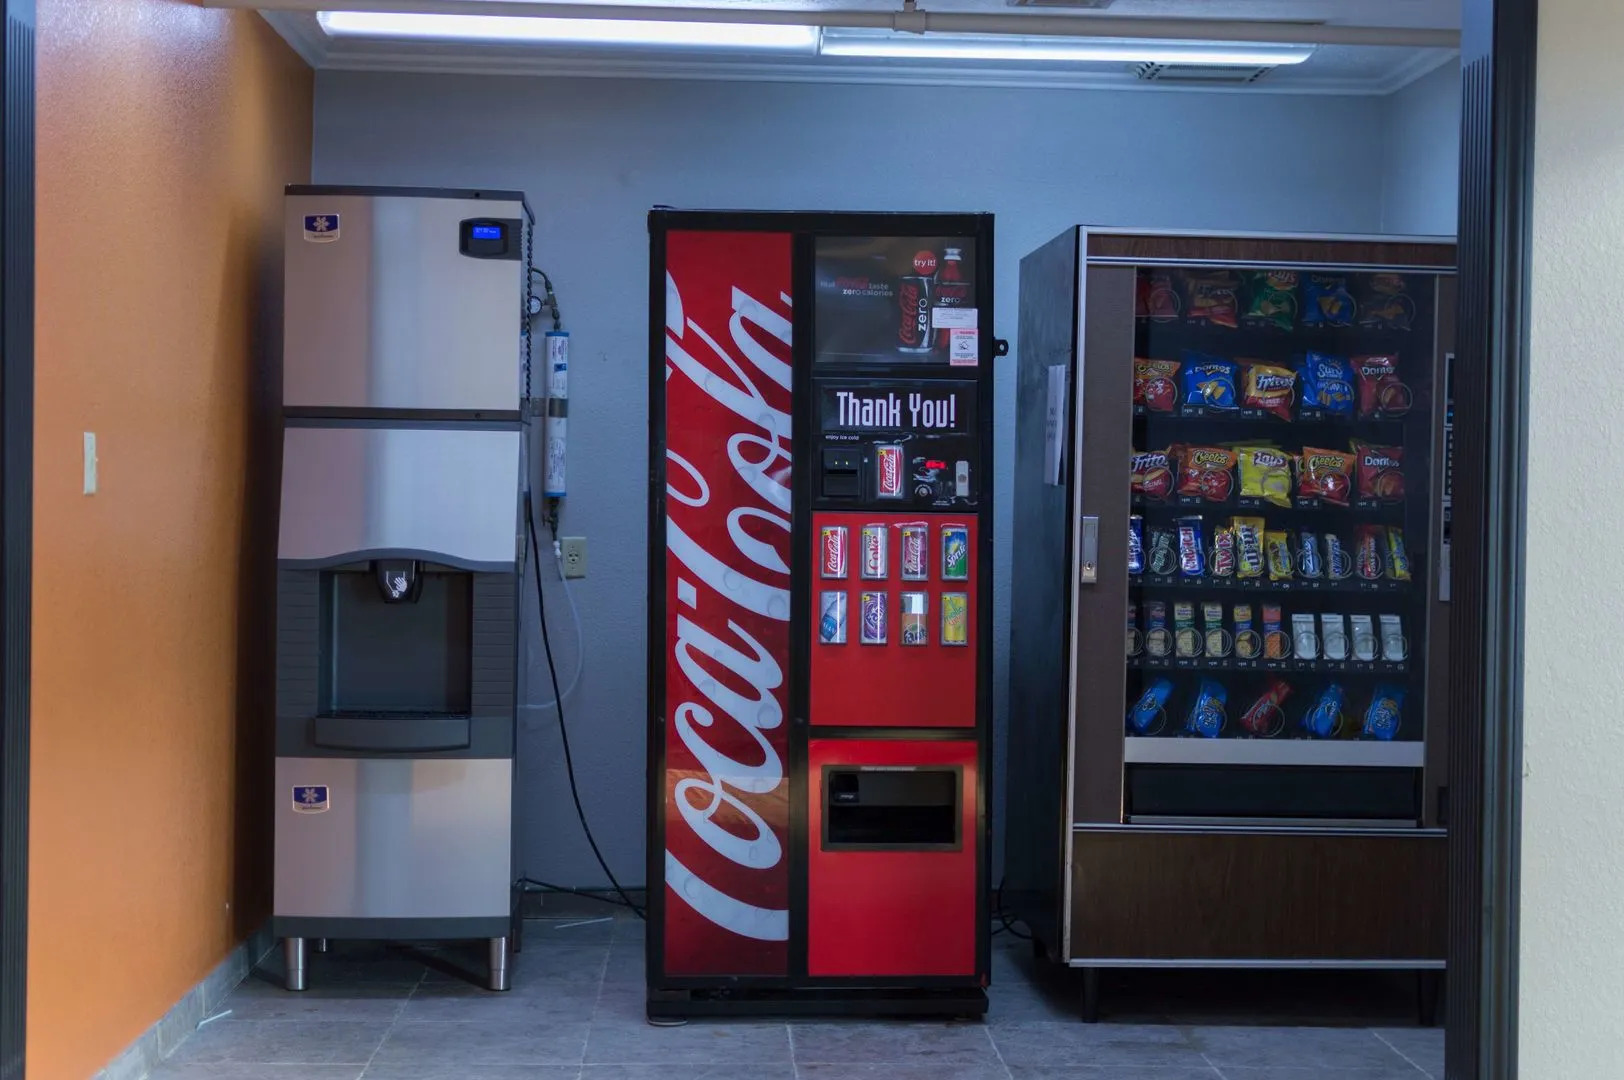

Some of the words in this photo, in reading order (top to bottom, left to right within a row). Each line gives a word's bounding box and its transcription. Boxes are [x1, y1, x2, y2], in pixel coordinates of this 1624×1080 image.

[914, 259, 926, 268] try
[927, 259, 936, 267] it!
[842, 288, 861, 296] zero
[941, 295, 961, 303] zero
[918, 298, 928, 332] zero
[1194, 364, 1231, 375] Doritos
[836, 391, 901, 427] Thank
[908, 392, 956, 428] You!
[1193, 450, 1229, 465] Cheetos
[1308, 454, 1345, 470] Cheetos
[1364, 455, 1400, 467] Doritos
[868, 535, 880, 571] Coke
[946, 544, 966, 567] Sprite
[1179, 527, 1198, 570] CRUNCH
